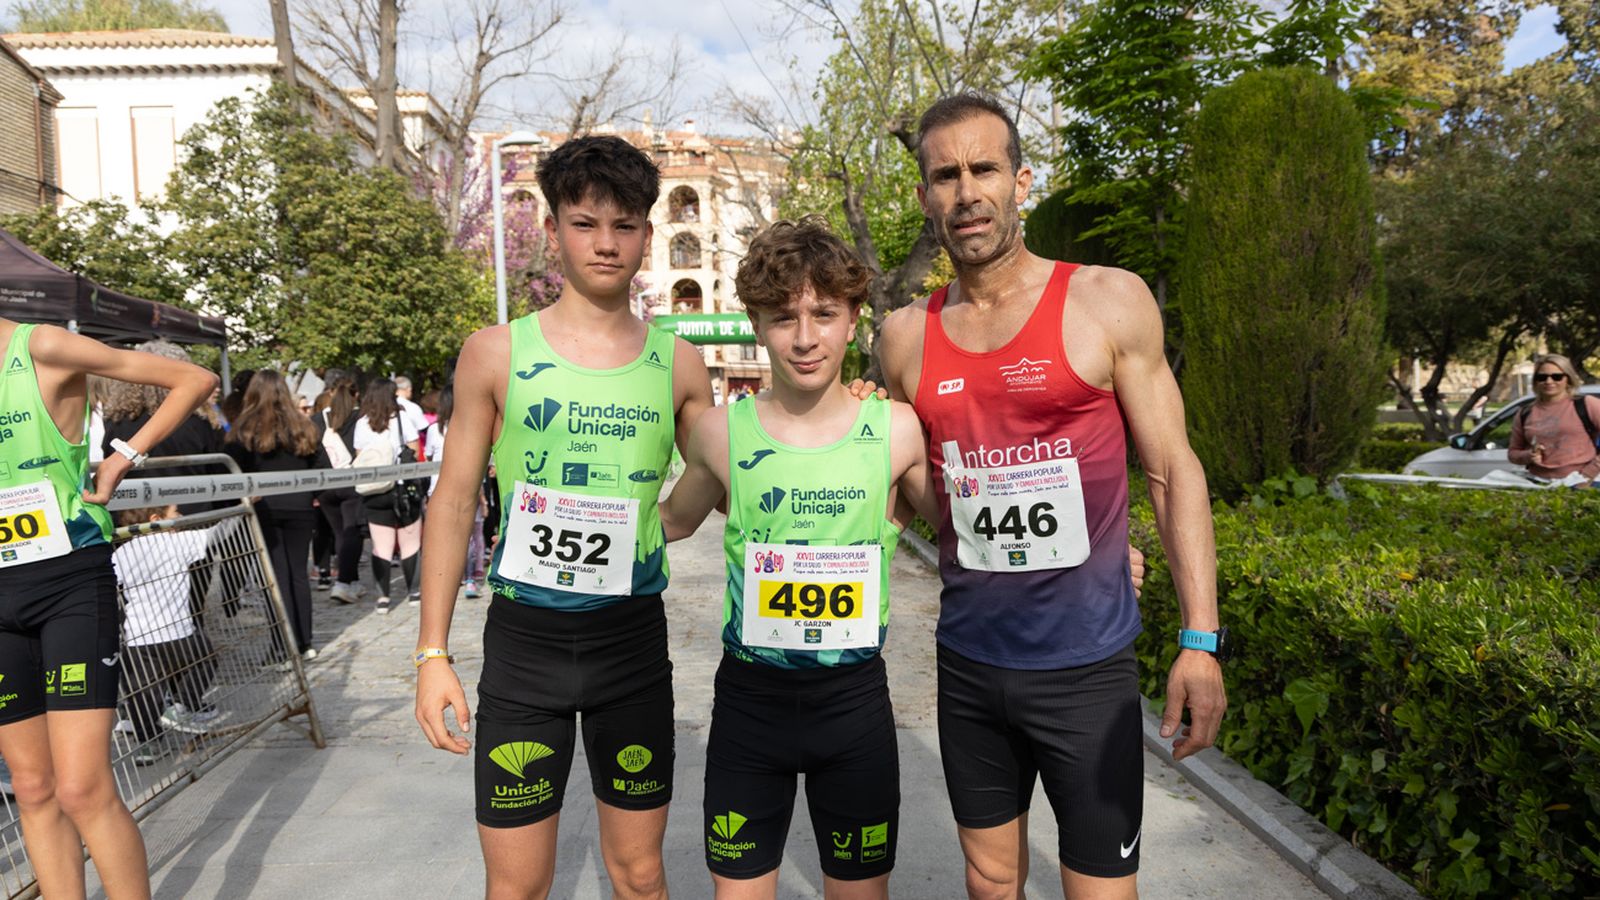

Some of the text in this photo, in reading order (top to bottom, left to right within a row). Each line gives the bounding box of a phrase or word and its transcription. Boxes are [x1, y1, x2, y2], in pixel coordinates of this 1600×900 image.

[674, 321, 714, 336] JUNTA
[719, 321, 736, 336] DE
[568, 401, 660, 424] Fundación
[568, 418, 637, 441] Unicaja
[567, 440, 597, 453] Jaén
[988, 465, 1063, 482] XXVII CARRERA POPULAR
[791, 486, 866, 501] Fundación
[558, 497, 626, 512] XXVII CARRERA POPULAR
[791, 501, 846, 518] Unicaja
[0, 513, 39, 544] 50
[791, 519, 816, 530] Jaén
[973, 502, 1058, 541] 446
[530, 524, 611, 567] 352
[796, 551, 866, 561] XXVII CARRERA POPULAR
[539, 560, 596, 574] MARIO SANTIAGO
[769, 583, 854, 619] 496
[804, 620, 832, 628] GARZON
[495, 778, 550, 797] Unicaja
[626, 779, 657, 791] Jaén
[491, 798, 538, 809] Fundación
[708, 836, 756, 851] Fundación
[709, 844, 742, 860] Unicaja
